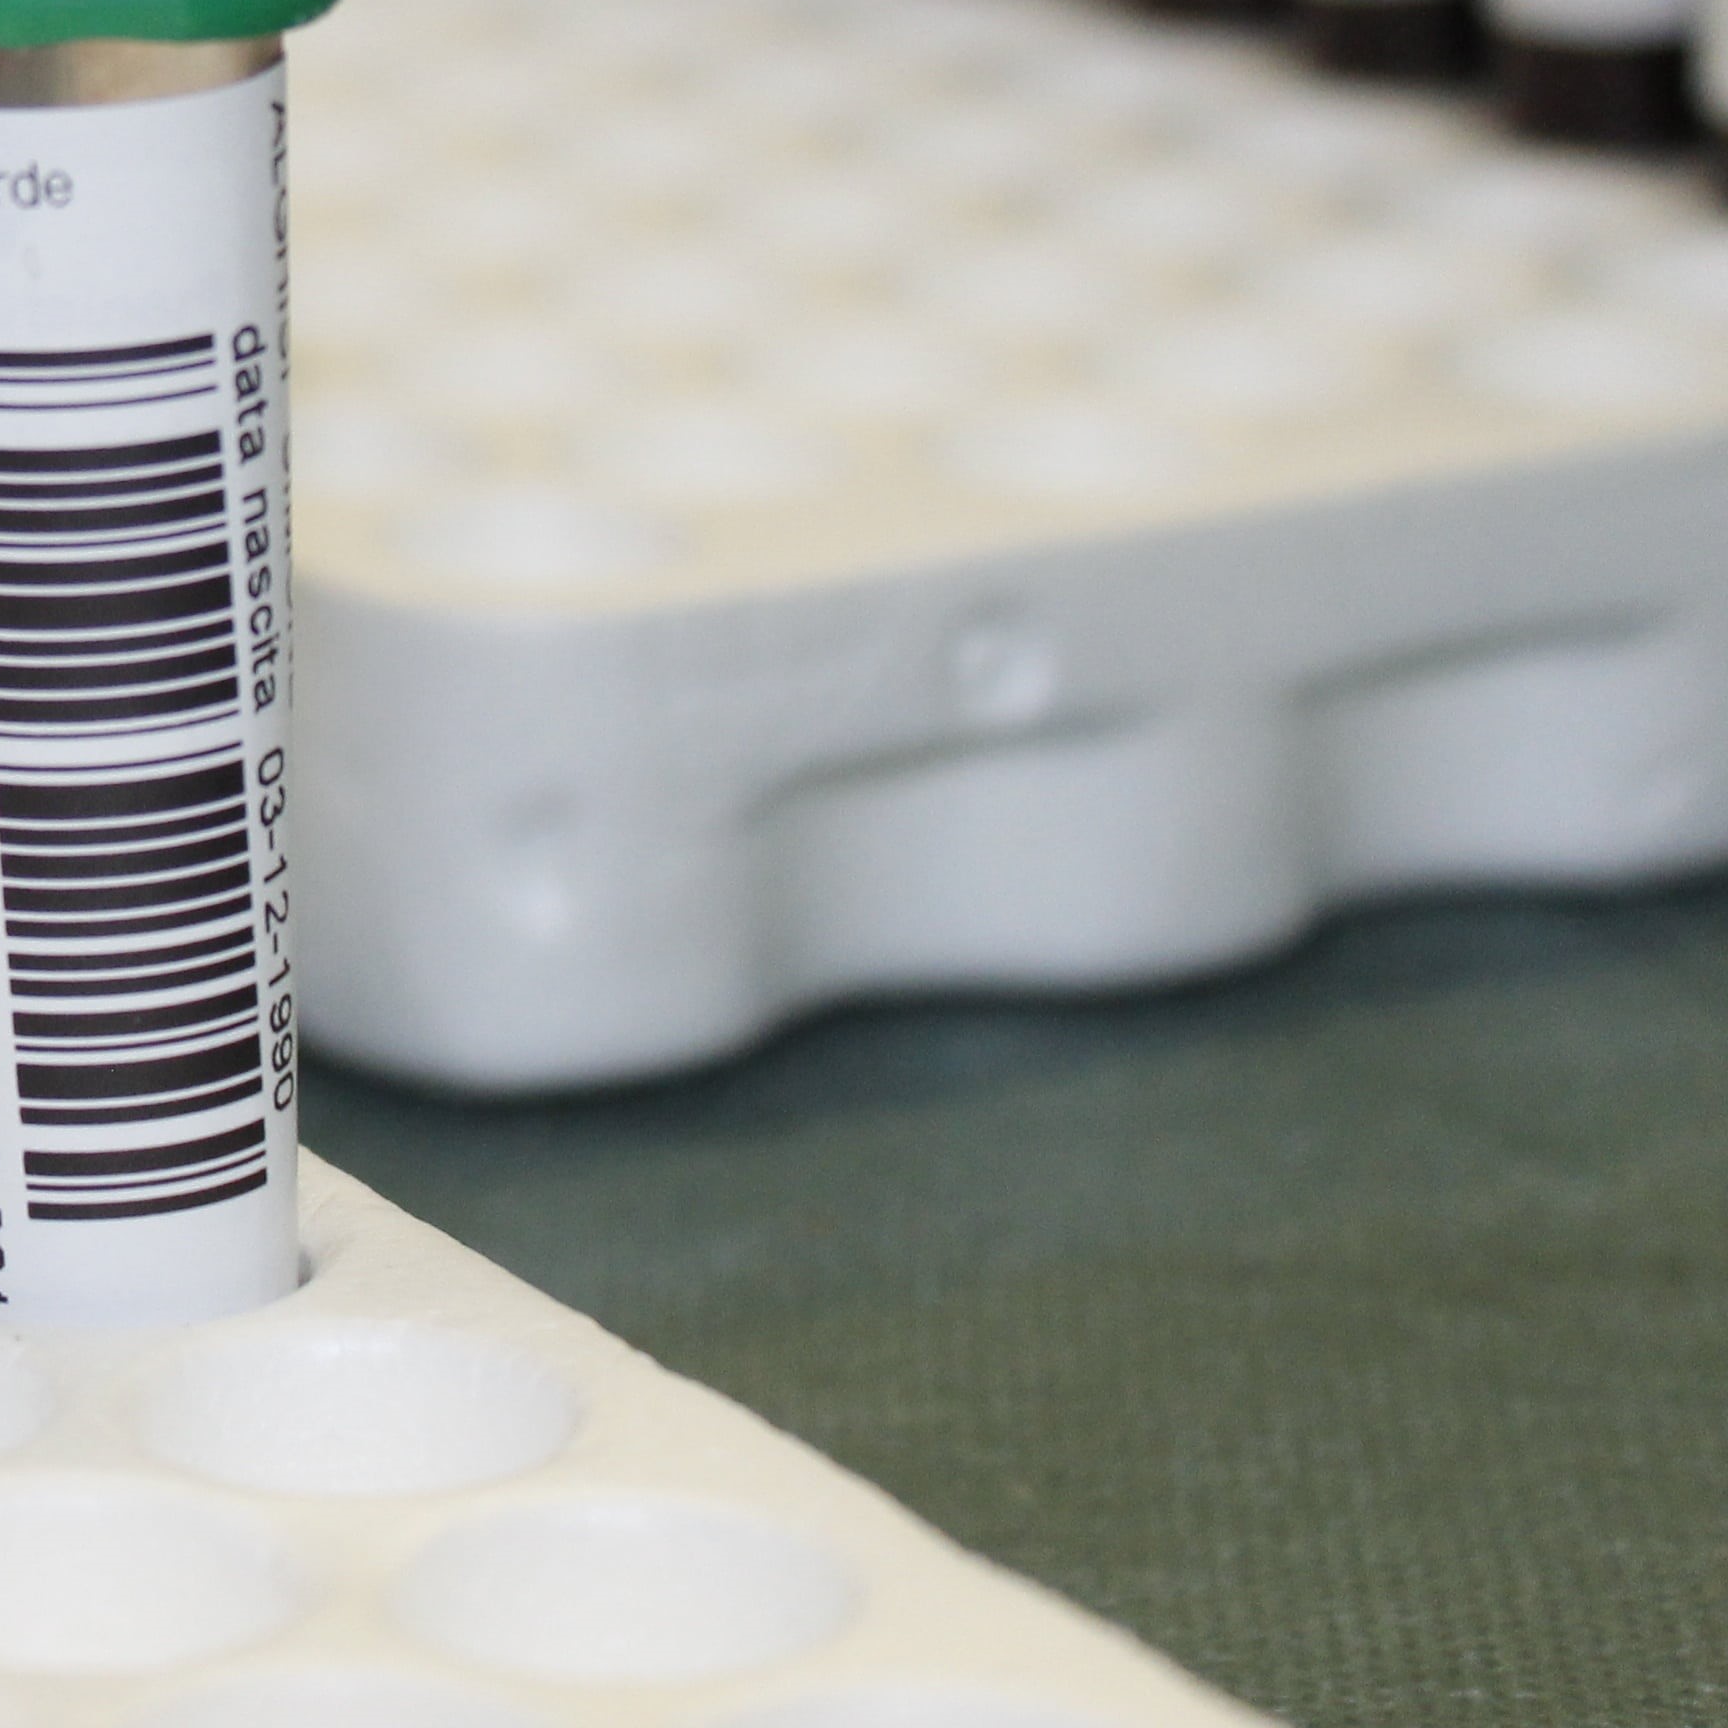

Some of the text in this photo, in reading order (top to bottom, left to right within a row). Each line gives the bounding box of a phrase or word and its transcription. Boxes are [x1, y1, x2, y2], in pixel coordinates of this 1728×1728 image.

[231, 324, 295, 1113] data nascita 03-12-1990
